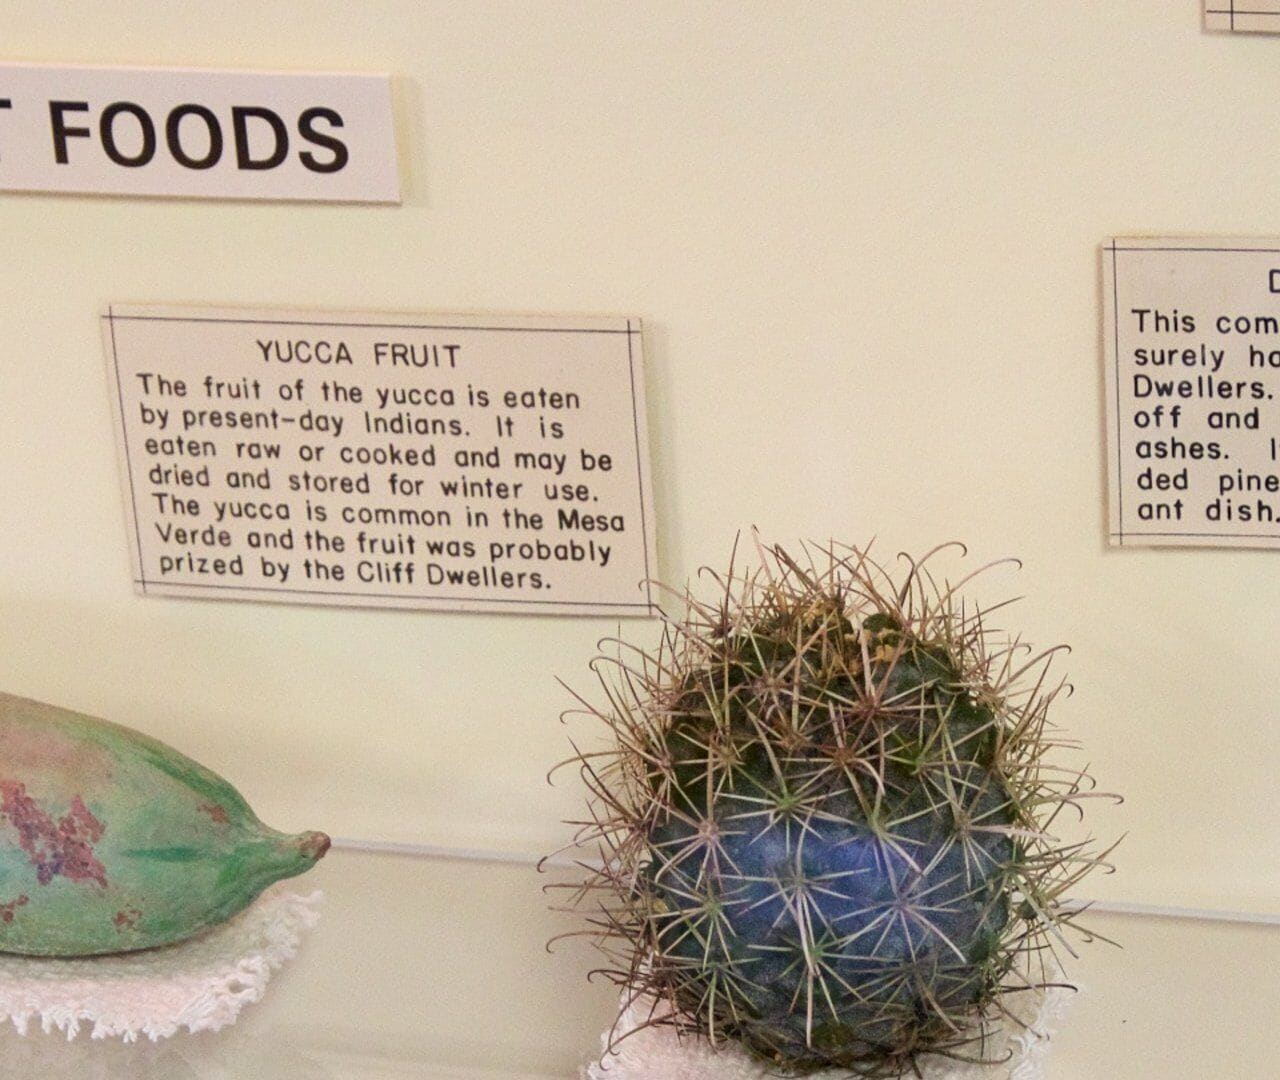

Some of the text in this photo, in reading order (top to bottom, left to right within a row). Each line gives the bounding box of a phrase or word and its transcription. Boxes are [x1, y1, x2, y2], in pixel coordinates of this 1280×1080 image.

[49, 100, 348, 174] FOODS
[1130, 308, 1196, 334] This
[255, 339, 461, 369] YUCCA FRUIT
[1133, 343, 1225, 373] surely
[135, 372, 581, 410] The fruit of the yucca is eaten
[1133, 373, 1273, 400] Dwellers.
[139, 402, 565, 440] by present-day Indians. It is
[144, 435, 613, 476] eaten raw or cooked and may be
